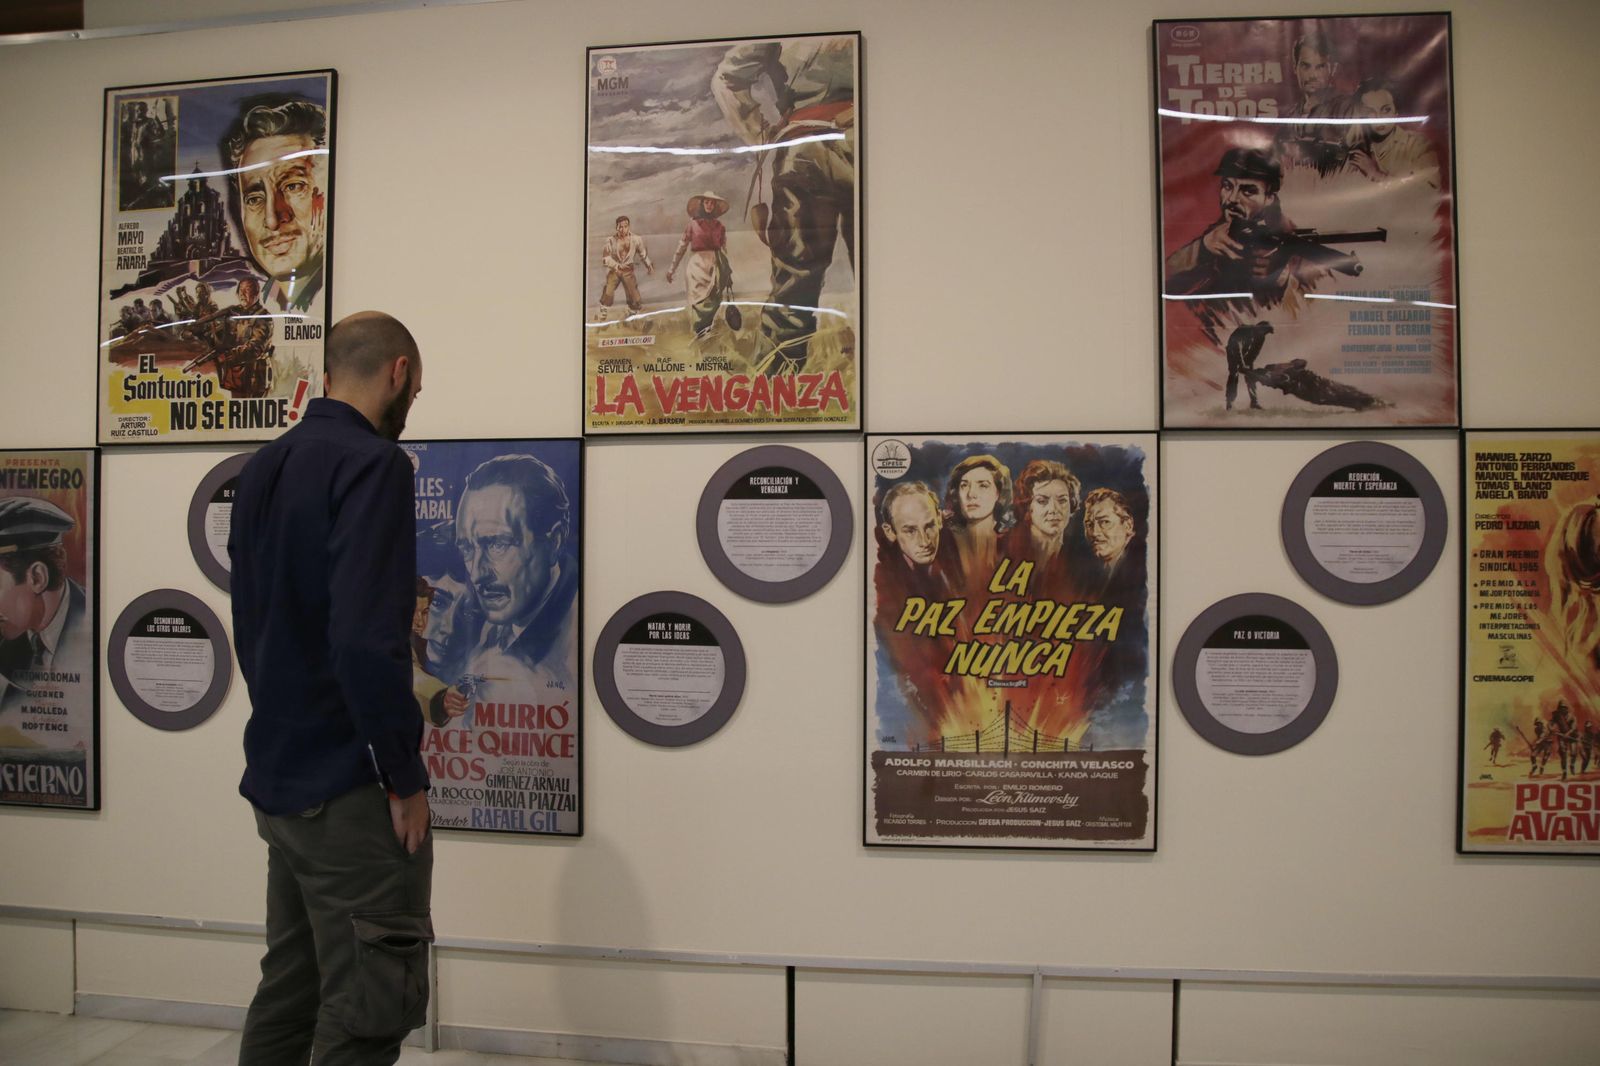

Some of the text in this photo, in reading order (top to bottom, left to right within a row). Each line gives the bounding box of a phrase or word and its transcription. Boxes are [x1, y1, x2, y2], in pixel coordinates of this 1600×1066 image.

[1167, 55, 1283, 86] TIERRA
[597, 77, 629, 91] MGM
[1218, 86, 1248, 98] DE
[118, 231, 144, 246] MAYO
[117, 255, 147, 270] AÑARA
[284, 325, 322, 340] BLANCO
[139, 355, 158, 373] EL
[597, 362, 734, 373] SEVILLA VALLONE MISTRAL
[124, 374, 213, 402] Santuario
[592, 370, 849, 416] LA VENGANZA
[170, 401, 197, 430] NO
[202, 400, 225, 430] SE
[128, 429, 158, 437] CASTILLO
[1475, 452, 1552, 461] MANUEL ZARZO
[1475, 462, 1576, 471] ANTONIO FERRANDIS
[1475, 472, 1589, 482] MANUEL MANZANEQUE
[761, 485, 788, 494] VENGANZA
[1333, 481, 1355, 490] MUERTE
[1365, 481, 1398, 491] ESPERANZA
[1475, 481, 1552, 490] TOMAS BLANCO
[1475, 490, 1548, 499] ANGELA BRAVO
[1475, 521, 1503, 530] PEDRO
[1480, 550, 1539, 559] GRAN PREMIO
[1480, 562, 1517, 572] SINDICAL
[989, 558, 1035, 597] LA
[895, 597, 1124, 641] PAZ EMPIEZA
[649, 631, 690, 640] POR LAS IDEAS
[1234, 631, 1245, 639] PAZ
[1254, 631, 1280, 640] VICTORIA
[945, 640, 1073, 678] NUNCA
[26, 690, 64, 698] GUERNER
[474, 700, 570, 730] MURIÓ
[22, 722, 68, 732] ROPTENCE
[420, 729, 575, 758] ACE QUINCE
[884, 758, 1135, 769] ADOLFO MARSILLACH CONCHITA VELASCO
[0, 763, 84, 795] FIERNO
[486, 774, 570, 792] GIMENEZ ARNAU
[441, 786, 484, 800] ROCCO
[1011, 791, 1079, 809] Klimovsky
[484, 789, 576, 812] MARIA PIAZZAI
[471, 808, 528, 831] RAFAEL
[529, 811, 562, 832] GIL
